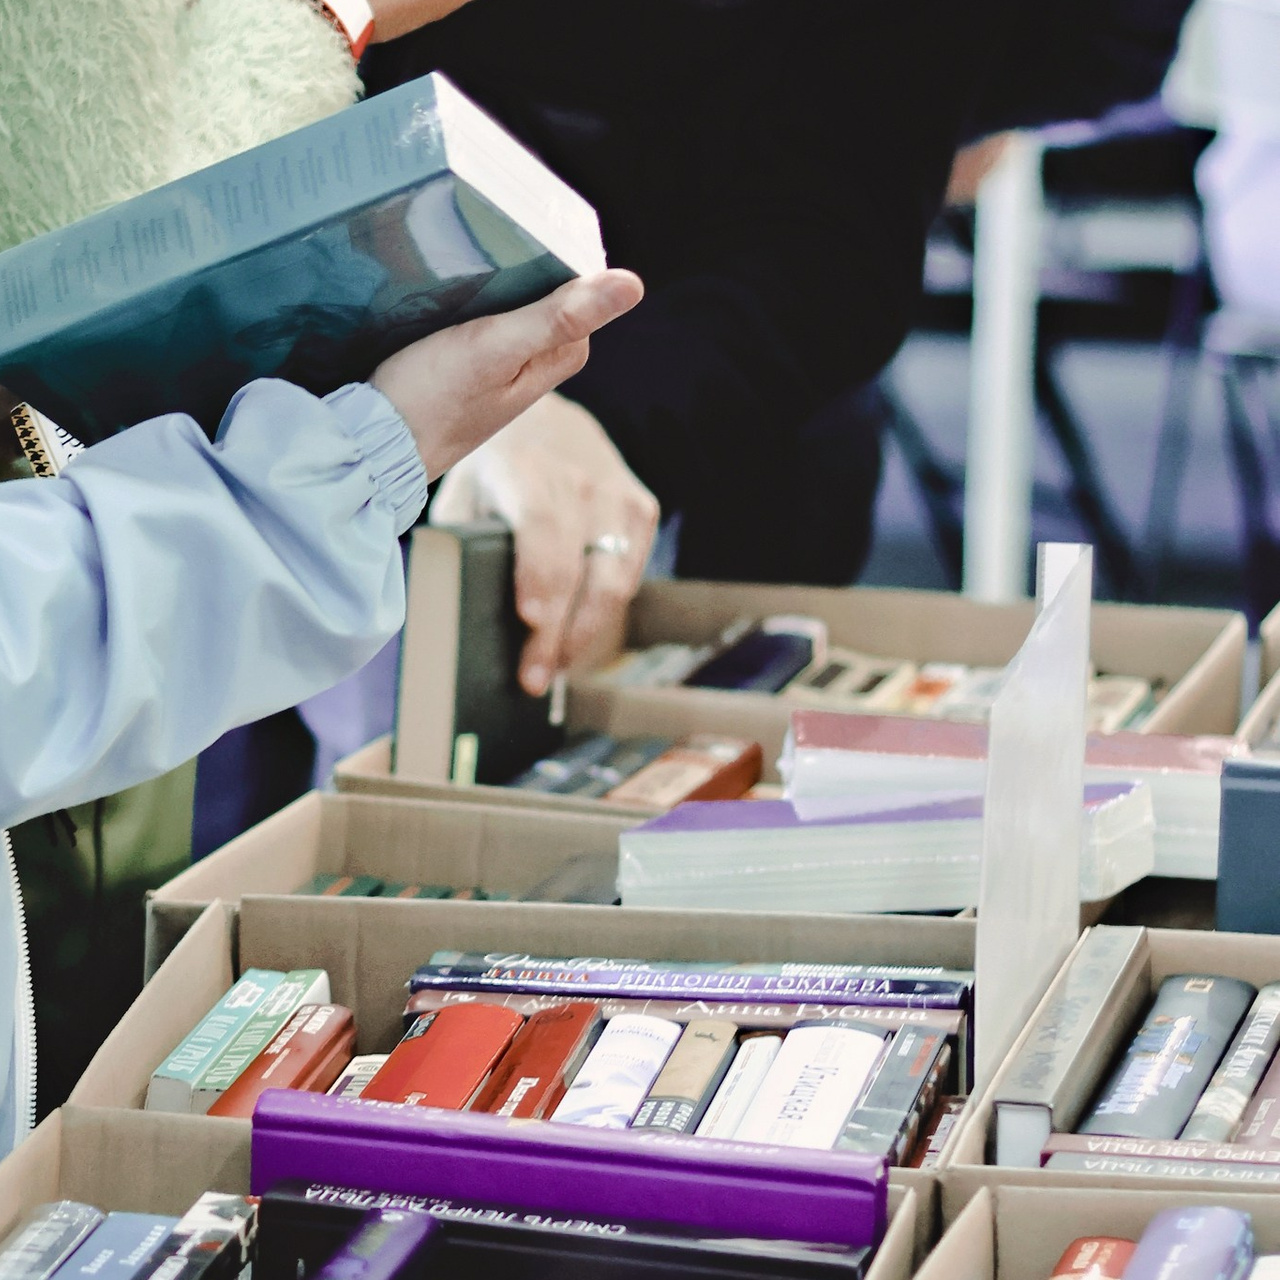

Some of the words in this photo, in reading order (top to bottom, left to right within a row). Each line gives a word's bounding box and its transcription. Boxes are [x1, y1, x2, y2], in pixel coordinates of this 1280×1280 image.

[618, 971, 750, 989] ВИКТОРИЯ
[763, 975, 891, 994] ТОКАРЕВА
[676, 1000, 782, 1018] Дина
[796, 1003, 928, 1023] Рубина
[1087, 1140, 1203, 1158] АВЕЛЬЦА
[1213, 1148, 1280, 1162] ЕНРО
[1213, 1167, 1280, 1181] ЕНРО
[429, 1204, 518, 1223] ЛЕНРО
[523, 1214, 627, 1236] СМЕРТЬ
